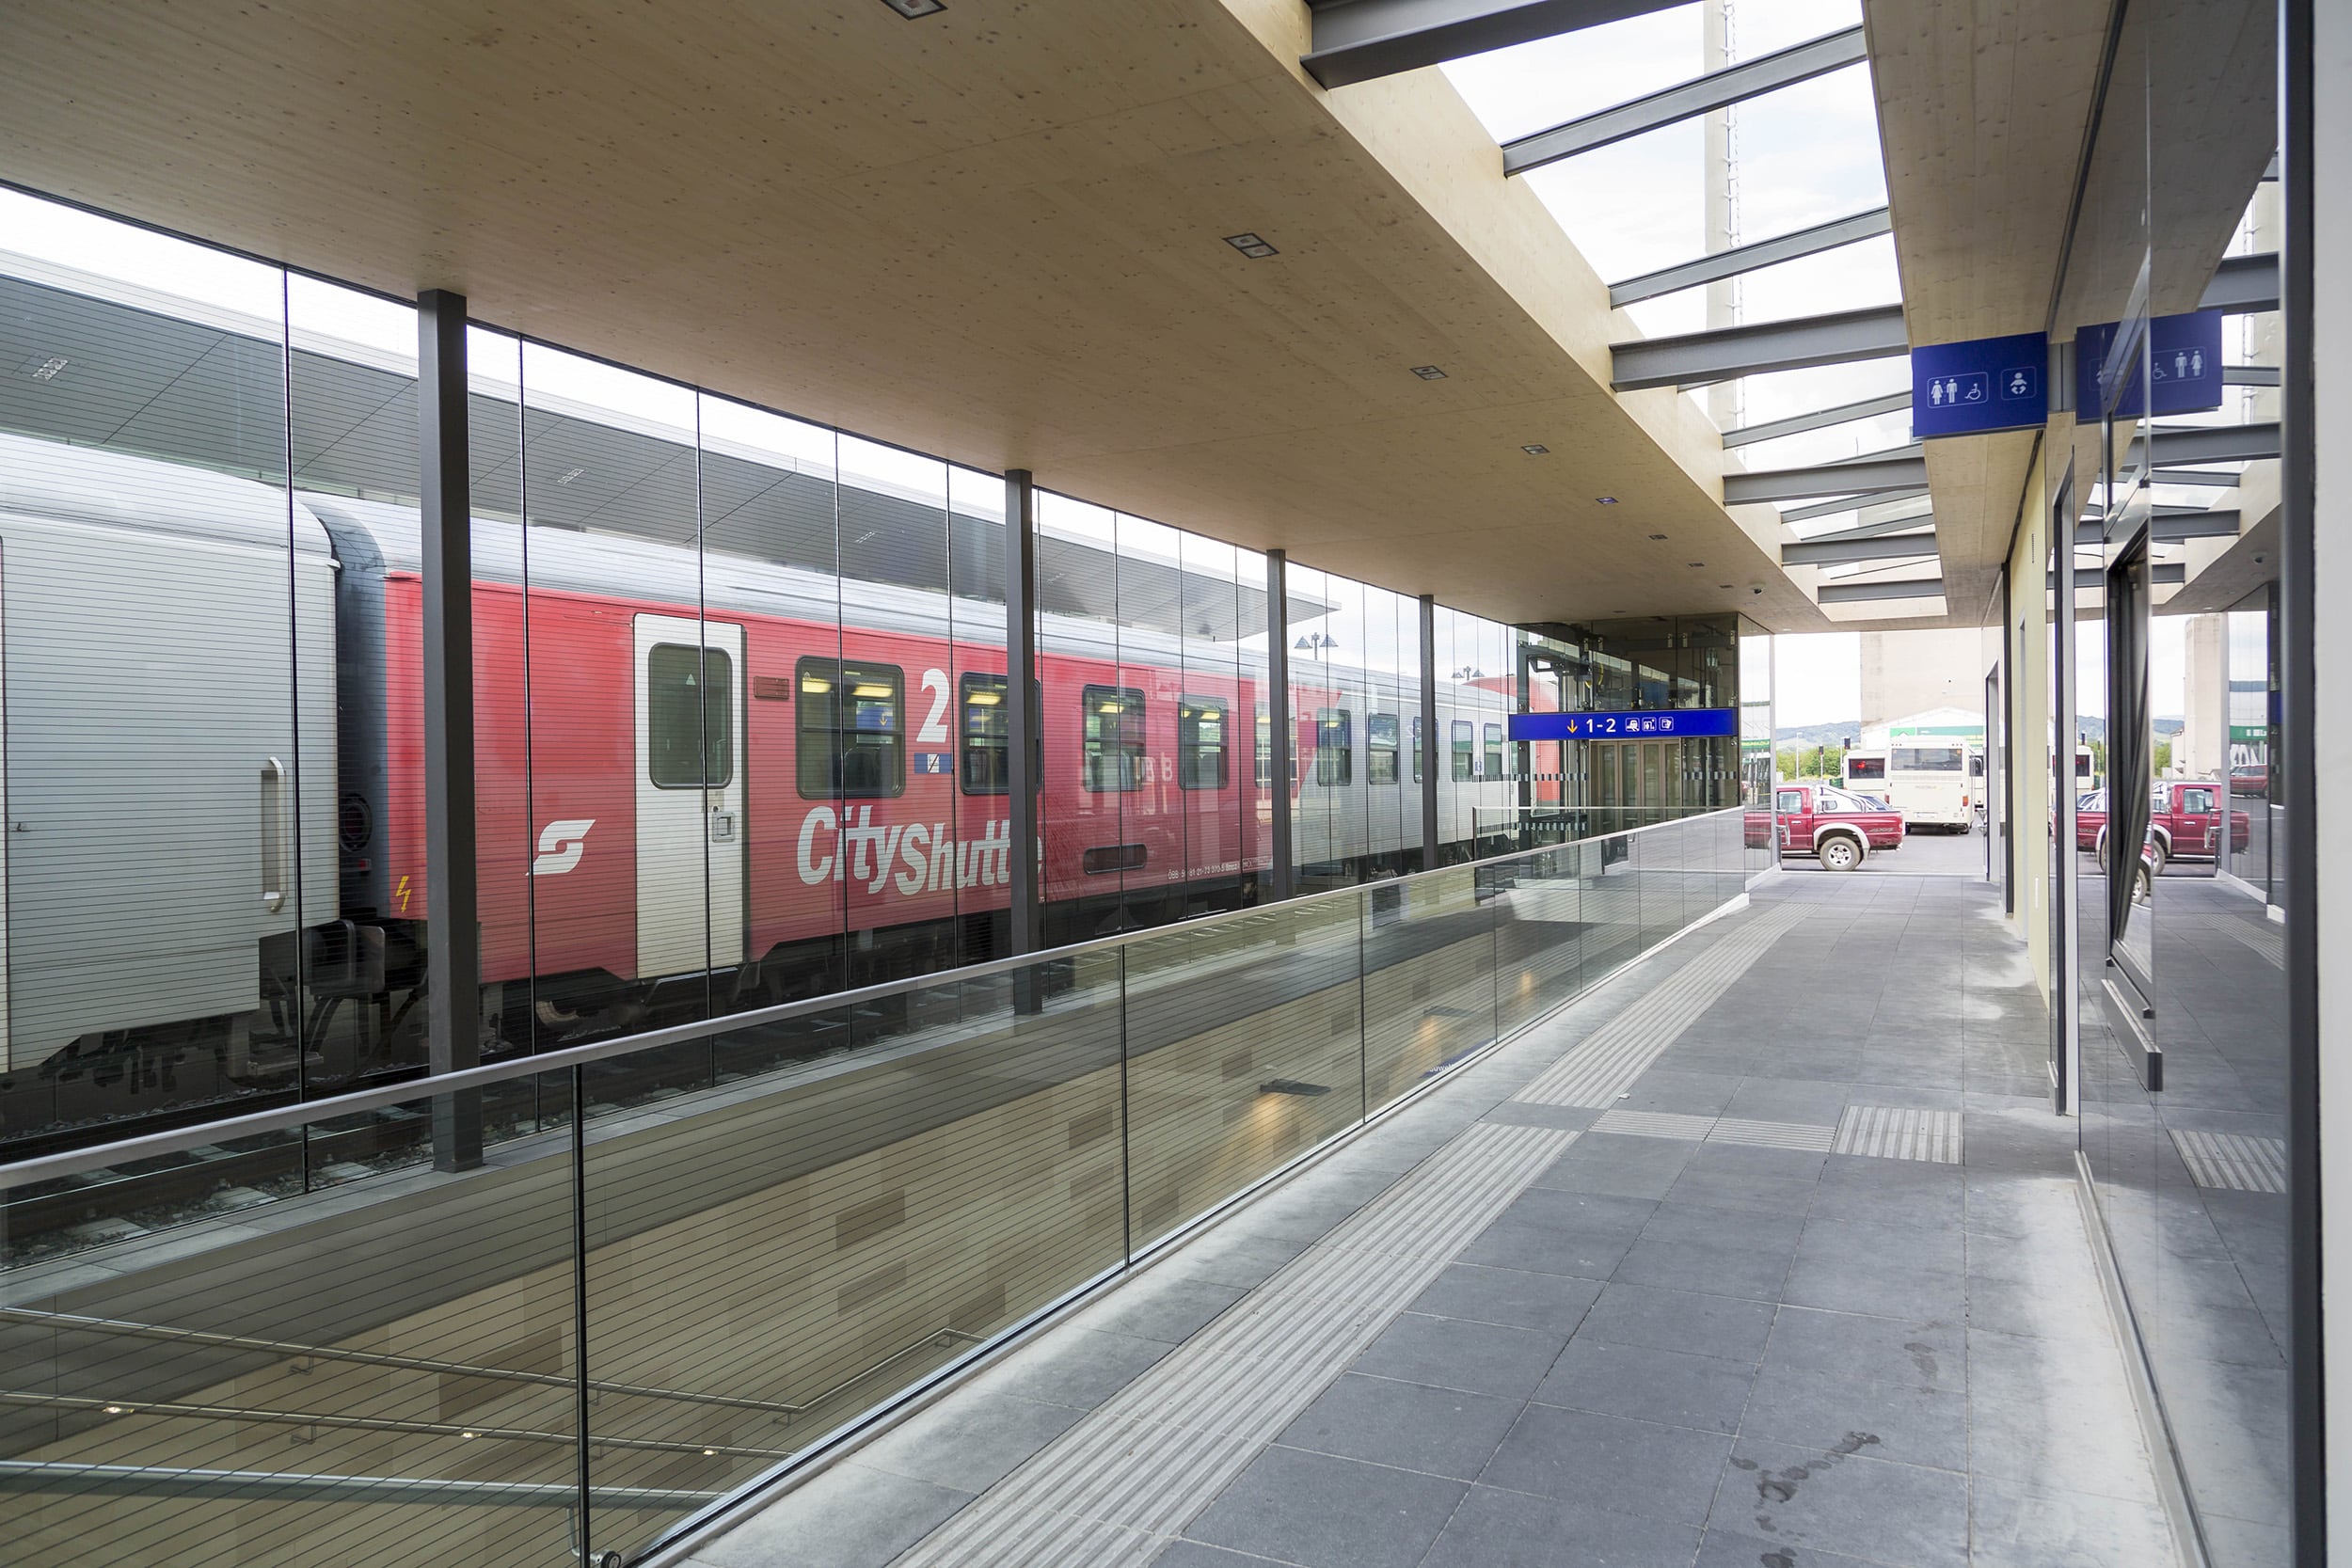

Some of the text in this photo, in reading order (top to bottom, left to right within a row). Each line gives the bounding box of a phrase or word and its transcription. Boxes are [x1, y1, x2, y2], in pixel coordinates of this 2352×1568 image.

[916, 669, 950, 743] 2
[1586, 718, 1616, 733] 1-2
[797, 805, 1043, 895] CityShutt
